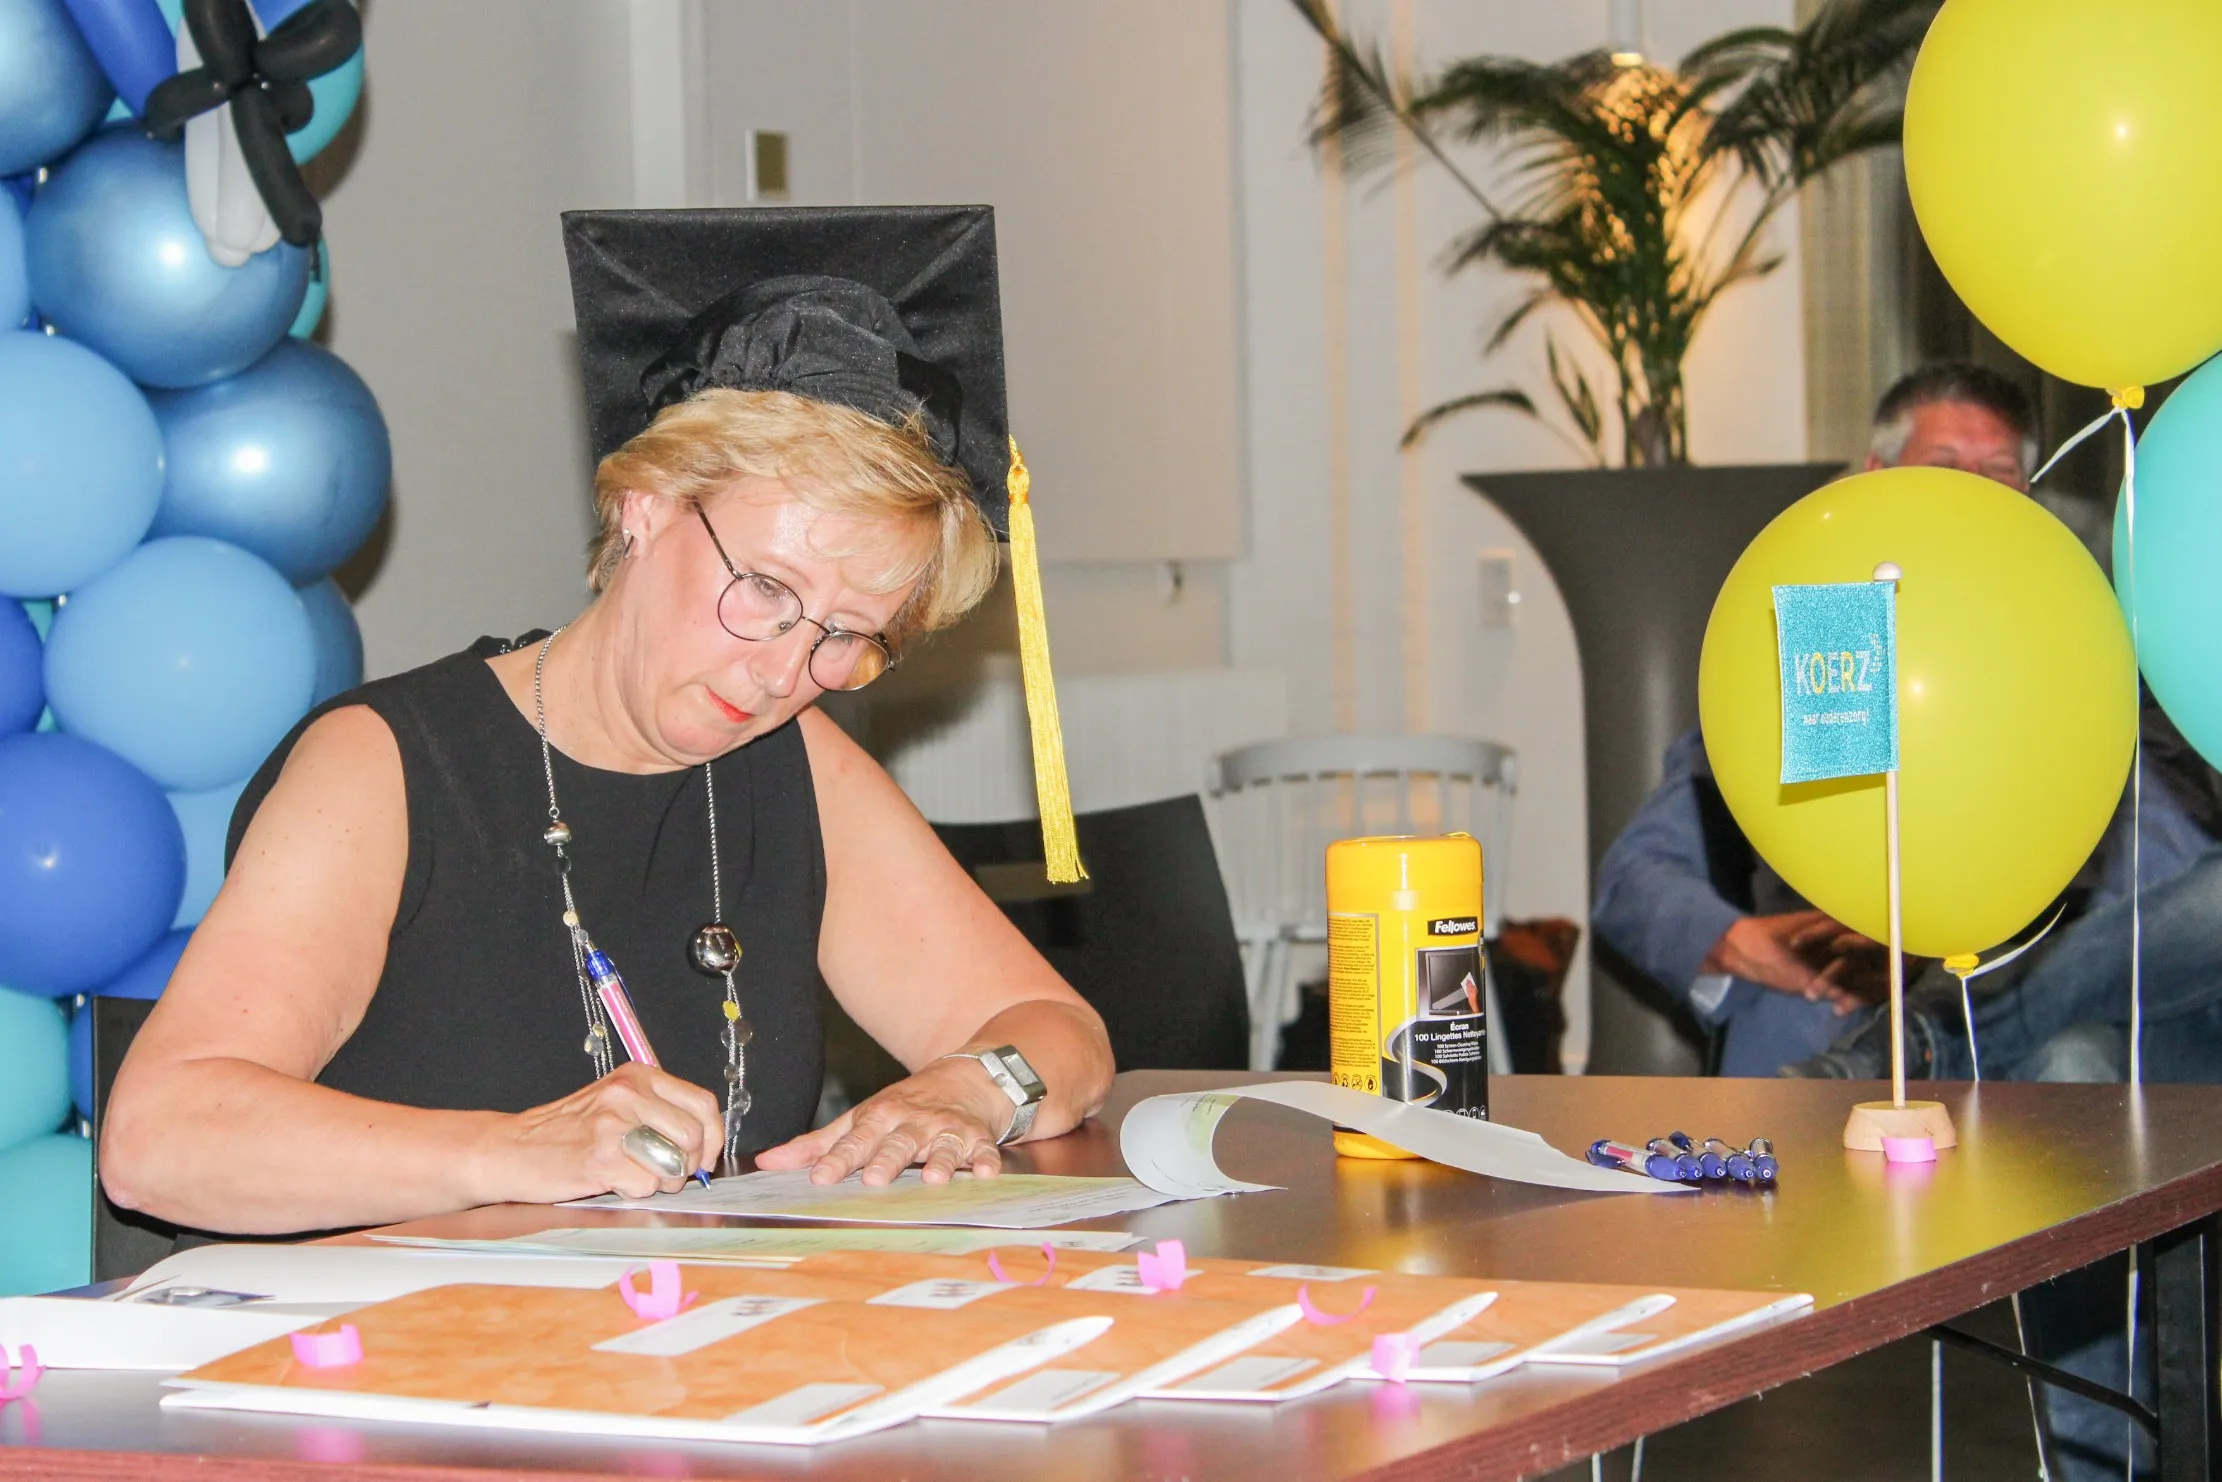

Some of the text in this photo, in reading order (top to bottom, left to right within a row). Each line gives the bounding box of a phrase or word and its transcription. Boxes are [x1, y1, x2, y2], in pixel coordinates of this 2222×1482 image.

[1794, 651, 1873, 695] KOERZ
[1434, 920, 1476, 934] Fellowes
[1450, 1021, 1469, 1031] Écran
[1430, 1032, 1462, 1042] Lingettes
